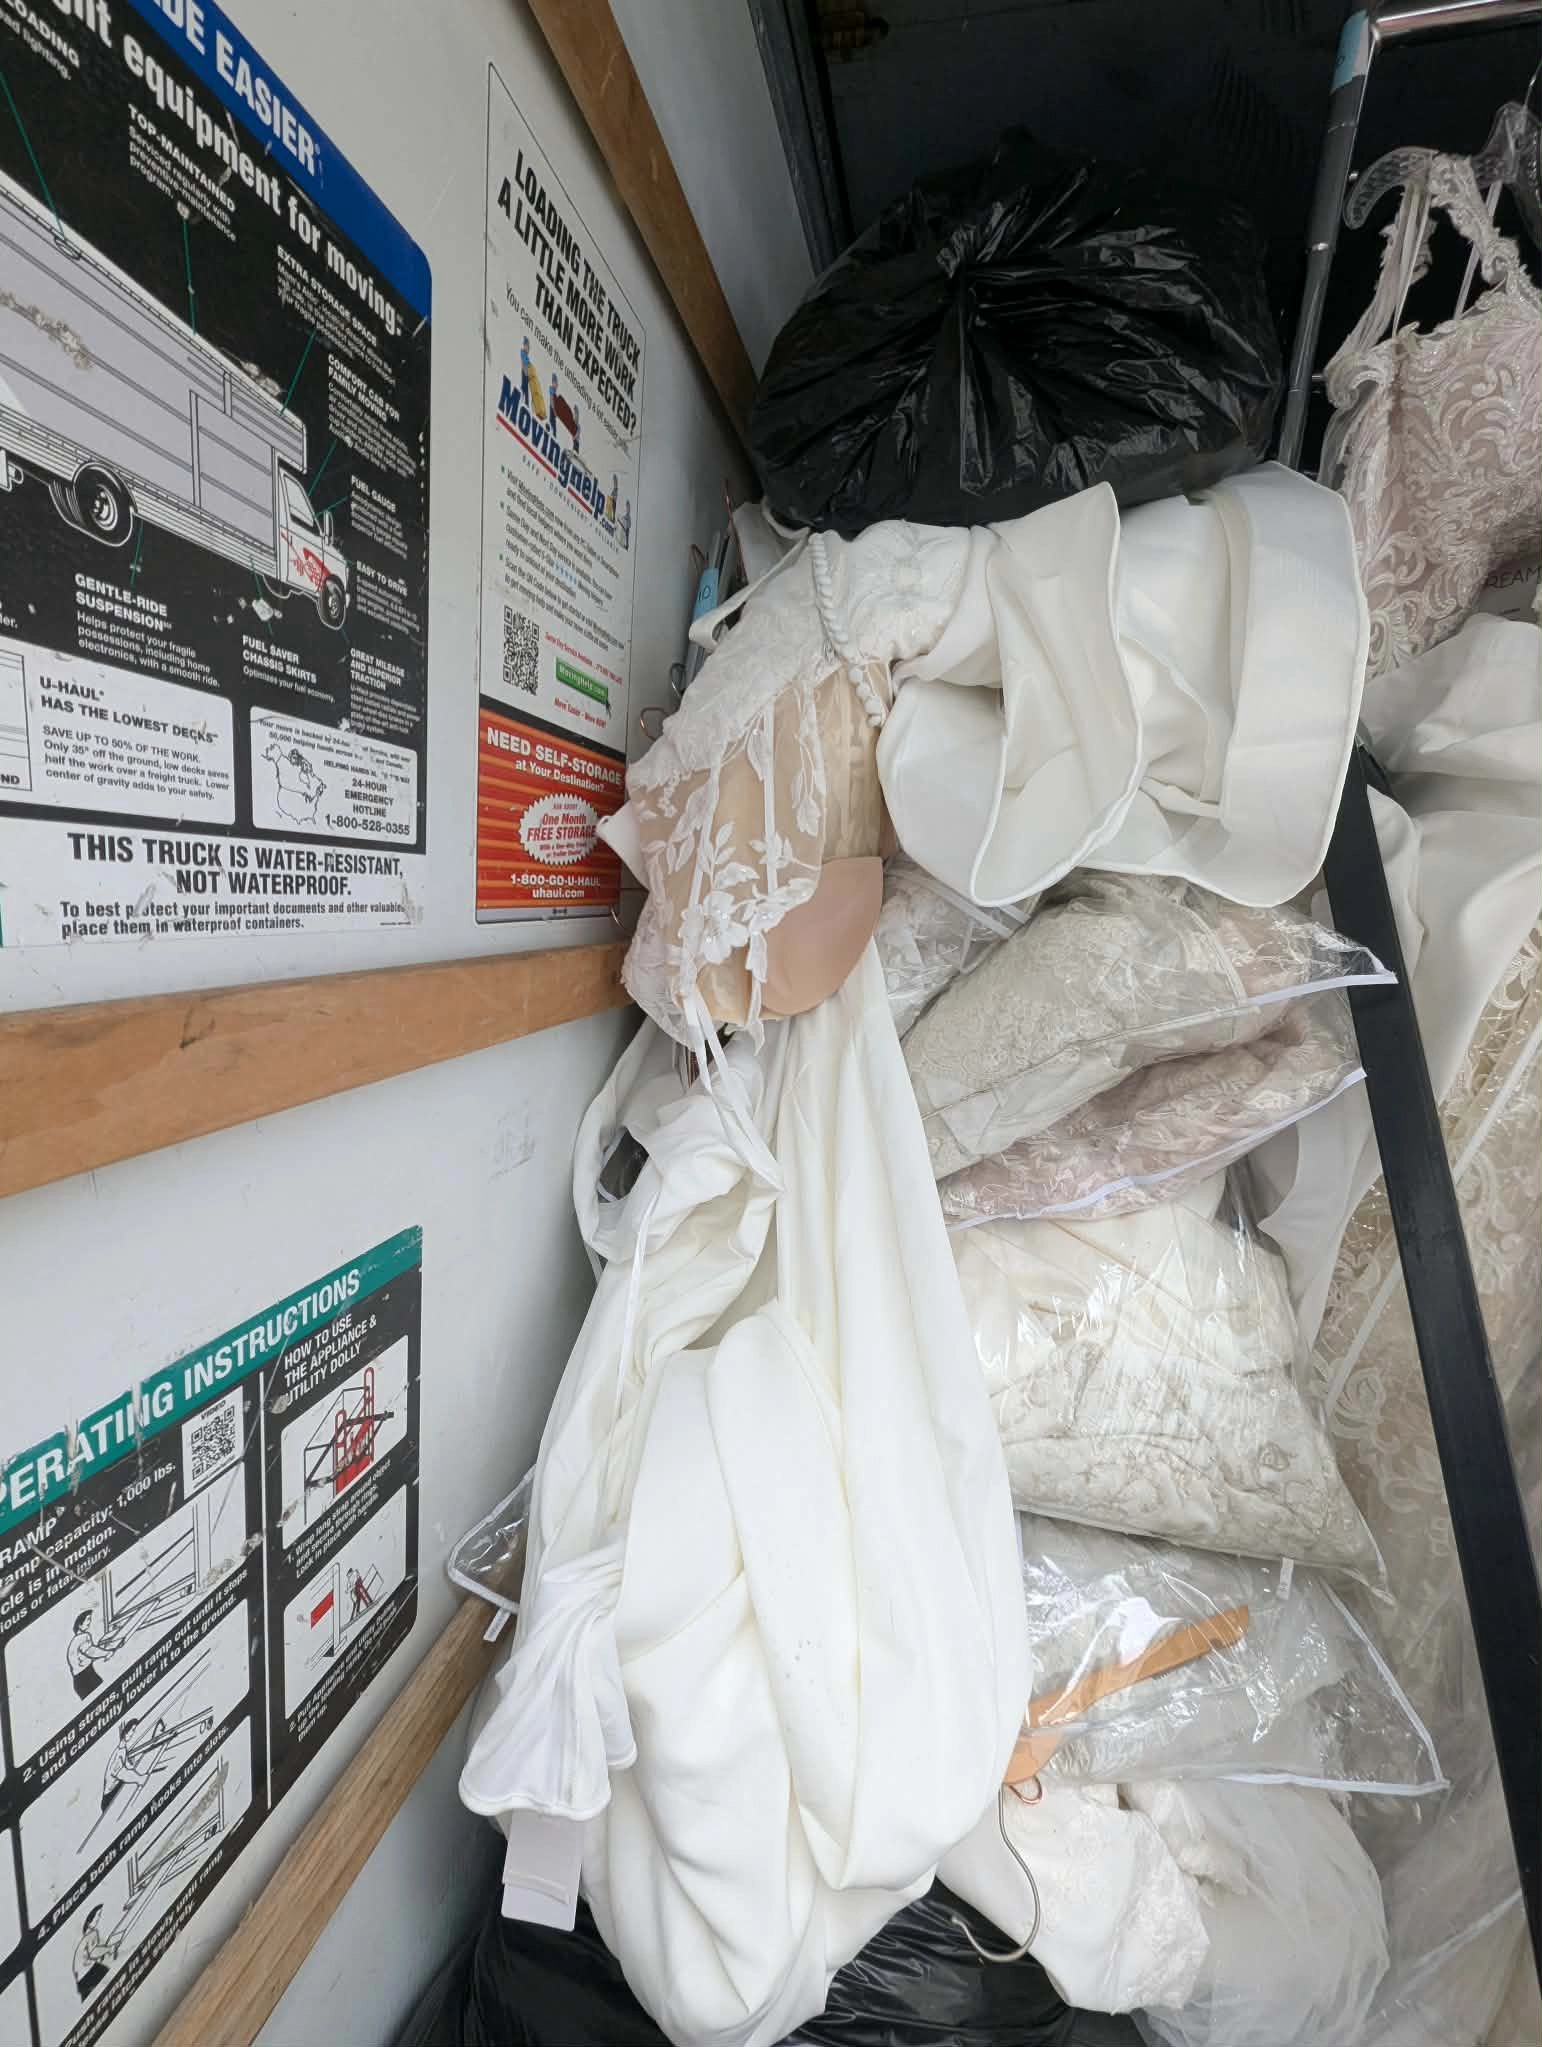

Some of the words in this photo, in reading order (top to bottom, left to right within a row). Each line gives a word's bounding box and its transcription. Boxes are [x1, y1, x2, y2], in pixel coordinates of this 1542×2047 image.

[123, 34, 282, 215] equipment
[287, 198, 321, 255] for
[128, 103, 236, 213] TOP-MAINTAINED
[515, 148, 581, 278] LOADING
[582, 257, 606, 317] THE
[606, 297, 641, 374] TRUCK
[277, 245, 309, 283] EXTRA
[311, 277, 351, 322] STORAGE
[352, 316, 377, 348] SPACE
[497, 175, 511, 220] A
[514, 197, 566, 296] LITTLE
[565, 277, 604, 353] MORE
[604, 334, 636, 402] WORK
[328, 353, 368, 393] COMFORT
[535, 273, 574, 352] THAN
[573, 333, 637, 438] EXPECTED?
[328, 366, 357, 396] FAMILY
[358, 391, 387, 422] MOVING
[352, 474, 371, 496] FUEL
[356, 560, 376, 578] EASY
[74, 573, 168, 617] GENTLE-RIDE
[77, 610, 107, 630] Helps
[109, 622, 145, 643] protect
[146, 635, 168, 650] your
[169, 641, 197, 659] fragile
[77, 625, 144, 655] possessions,
[78, 637, 138, 665] electronics,
[242, 634, 269, 653] FUEL
[270, 644, 299, 665] SAVER
[242, 649, 284, 673] CHASSIS
[285, 663, 317, 684] SKIRTS
[350, 648, 375, 666] GREAT
[375, 657, 405, 678] MILEAGE
[350, 670, 387, 691] TRACTION
[41, 695, 75, 713] HAS
[81, 703, 109, 721] THE
[113, 711, 169, 734] LOWEST
[43, 724, 73, 740] SAVE
[76, 732, 92, 743] UP
[95, 735, 109, 746] TO
[111, 738, 133, 750] 50%
[135, 742, 149, 753] OF
[151, 745, 169, 758] THE
[171, 749, 201, 763] WORK.
[44, 738, 71, 756] Only
[92, 748, 106, 758] off
[108, 750, 124, 763] the
[127, 754, 161, 770] ground,
[163, 760, 179, 772] low
[487, 726, 531, 756] NEED
[535, 744, 622, 785] SELF-STORAGE
[45, 753, 65, 765] half
[69, 756, 86, 769] the
[88, 759, 114, 772] work
[116, 766, 137, 777] over
[147, 769, 176, 786] freight
[206, 779, 229, 791] Lower
[46, 769, 81, 781] center
[84, 771, 95, 783] of
[97, 774, 130, 789] gravity
[132, 780, 155, 791] adds
[189, 787, 215, 801] safety.
[352, 778, 387, 793] 24-HOUR
[515, 759, 527, 772] at
[530, 761, 552, 778] Your
[344, 789, 394, 806] EMERGENCY
[352, 804, 387, 818] HOTLINE
[325, 814, 410, 836] 1-800-528-0355
[527, 826, 553, 842] FREE
[542, 813, 560, 826] One
[561, 813, 587, 825] Month
[67, 832, 133, 862] THIS
[142, 838, 222, 867] TRUCK
[229, 845, 248, 869] IS
[255, 848, 403, 879] WATER-RESISTANT,
[176, 869, 220, 894] NOT
[228, 871, 352, 896] WATERPROOF.
[510, 873, 601, 887] 1-800-GO-U-HAUL
[532, 887, 585, 899] uhaul.com
[60, 901, 80, 918] To
[86, 901, 120, 917] best
[125, 902, 178, 920] potect
[182, 905, 210, 919] your
[214, 901, 270, 916] important
[273, 902, 326, 914] documents
[328, 902, 344, 914] and
[347, 902, 369, 913] other
[62, 920, 108, 940] place
[114, 919, 152, 936] them
[156, 919, 169, 933] in
[173, 917, 242, 935] waterproof
[245, 917, 305, 930] containers.
[284, 1340, 313, 1371] HOW
[314, 1329, 330, 1349] TO
[332, 1312, 353, 1338] USE
[284, 1362, 309, 1388] THE
[310, 1320, 368, 1372] APPLIANCE
[369, 1313, 377, 1329] &
[329, 1340, 362, 1375] DOLLY
[0, 1379, 175, 1511] ERATING
[183, 1267, 361, 1402] INSTRUCTIONS
[45, 1503, 113, 1559] capacity:
[116, 1475, 151, 1508] 1,000
[153, 1460, 176, 1485] lbs.
[295, 1533, 316, 1556] Wrap
[332, 1500, 350, 1521] strap
[28, 1577, 42, 1596] is
[45, 1562, 61, 1582] in
[63, 1527, 117, 1569] motion.
[30, 1593, 45, 1610] or
[76, 1544, 111, 1577] injury.
[22, 1767, 37, 1784] 2.
[38, 1730, 76, 1767] Using
[78, 1691, 120, 1732] straps,
[121, 1666, 143, 1693] pull
[144, 1637, 174, 1675] ramp
[175, 1621, 191, 1641] out
[192, 1600, 214, 1624] until
[223, 1569, 249, 1597] stops
[41, 1757, 67, 1784] and
[70, 1700, 124, 1757] carefully
[126, 1671, 158, 1703] lower
[159, 1658, 168, 1673] it
[170, 1646, 181, 1662] to
[182, 1629, 200, 1649] the
[200, 1594, 238, 1632] ground.
[52, 1880, 88, 1924] Place
[89, 1847, 118, 1886] both
[118, 1812, 149, 1852] ramp
[150, 1776, 185, 1815] hooks
[184, 1751, 204, 1780] into
[203, 1726, 231, 1755] slots.
